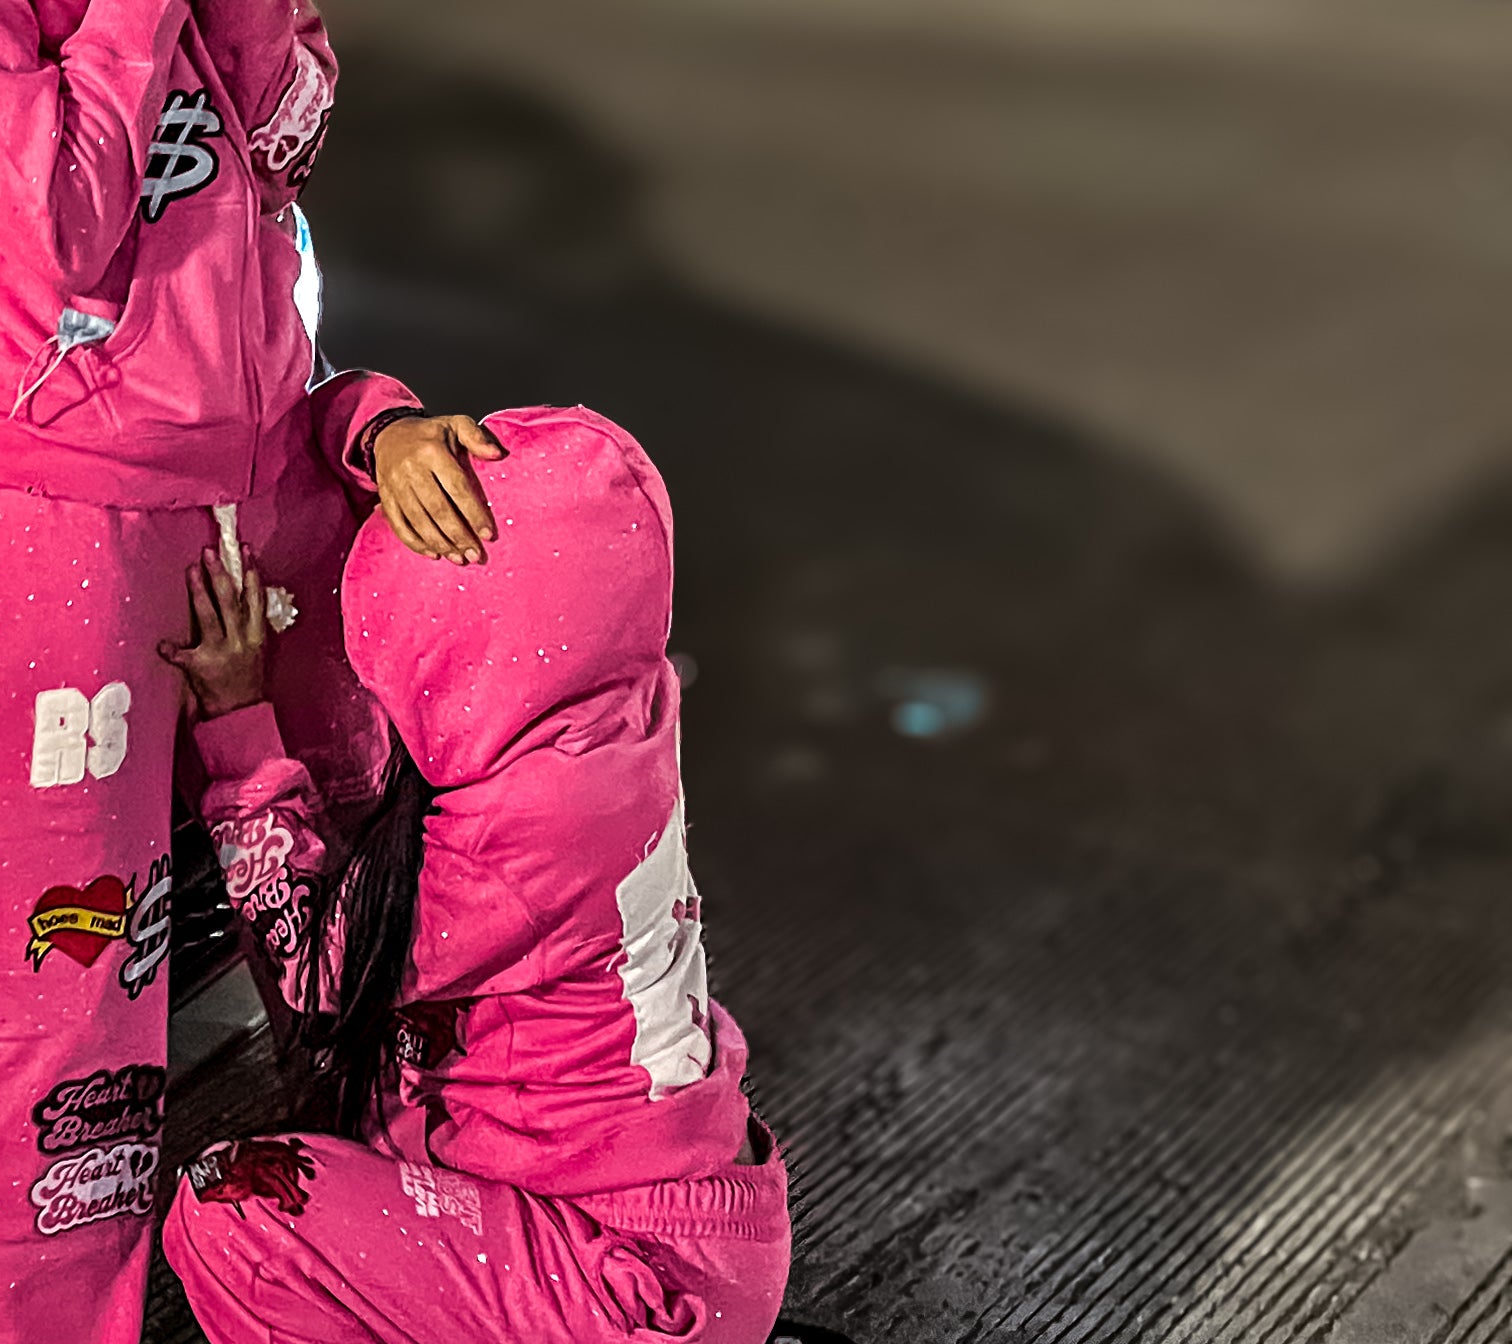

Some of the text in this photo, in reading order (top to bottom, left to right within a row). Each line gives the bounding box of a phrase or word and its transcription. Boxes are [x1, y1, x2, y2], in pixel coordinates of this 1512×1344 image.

[29, 681, 131, 788] RS
[89, 915, 123, 933] mad
[42, 1071, 129, 1121] Heart
[42, 1105, 155, 1151] Breaker
[39, 1148, 126, 1200] Heart
[41, 1180, 150, 1229] Breaker
